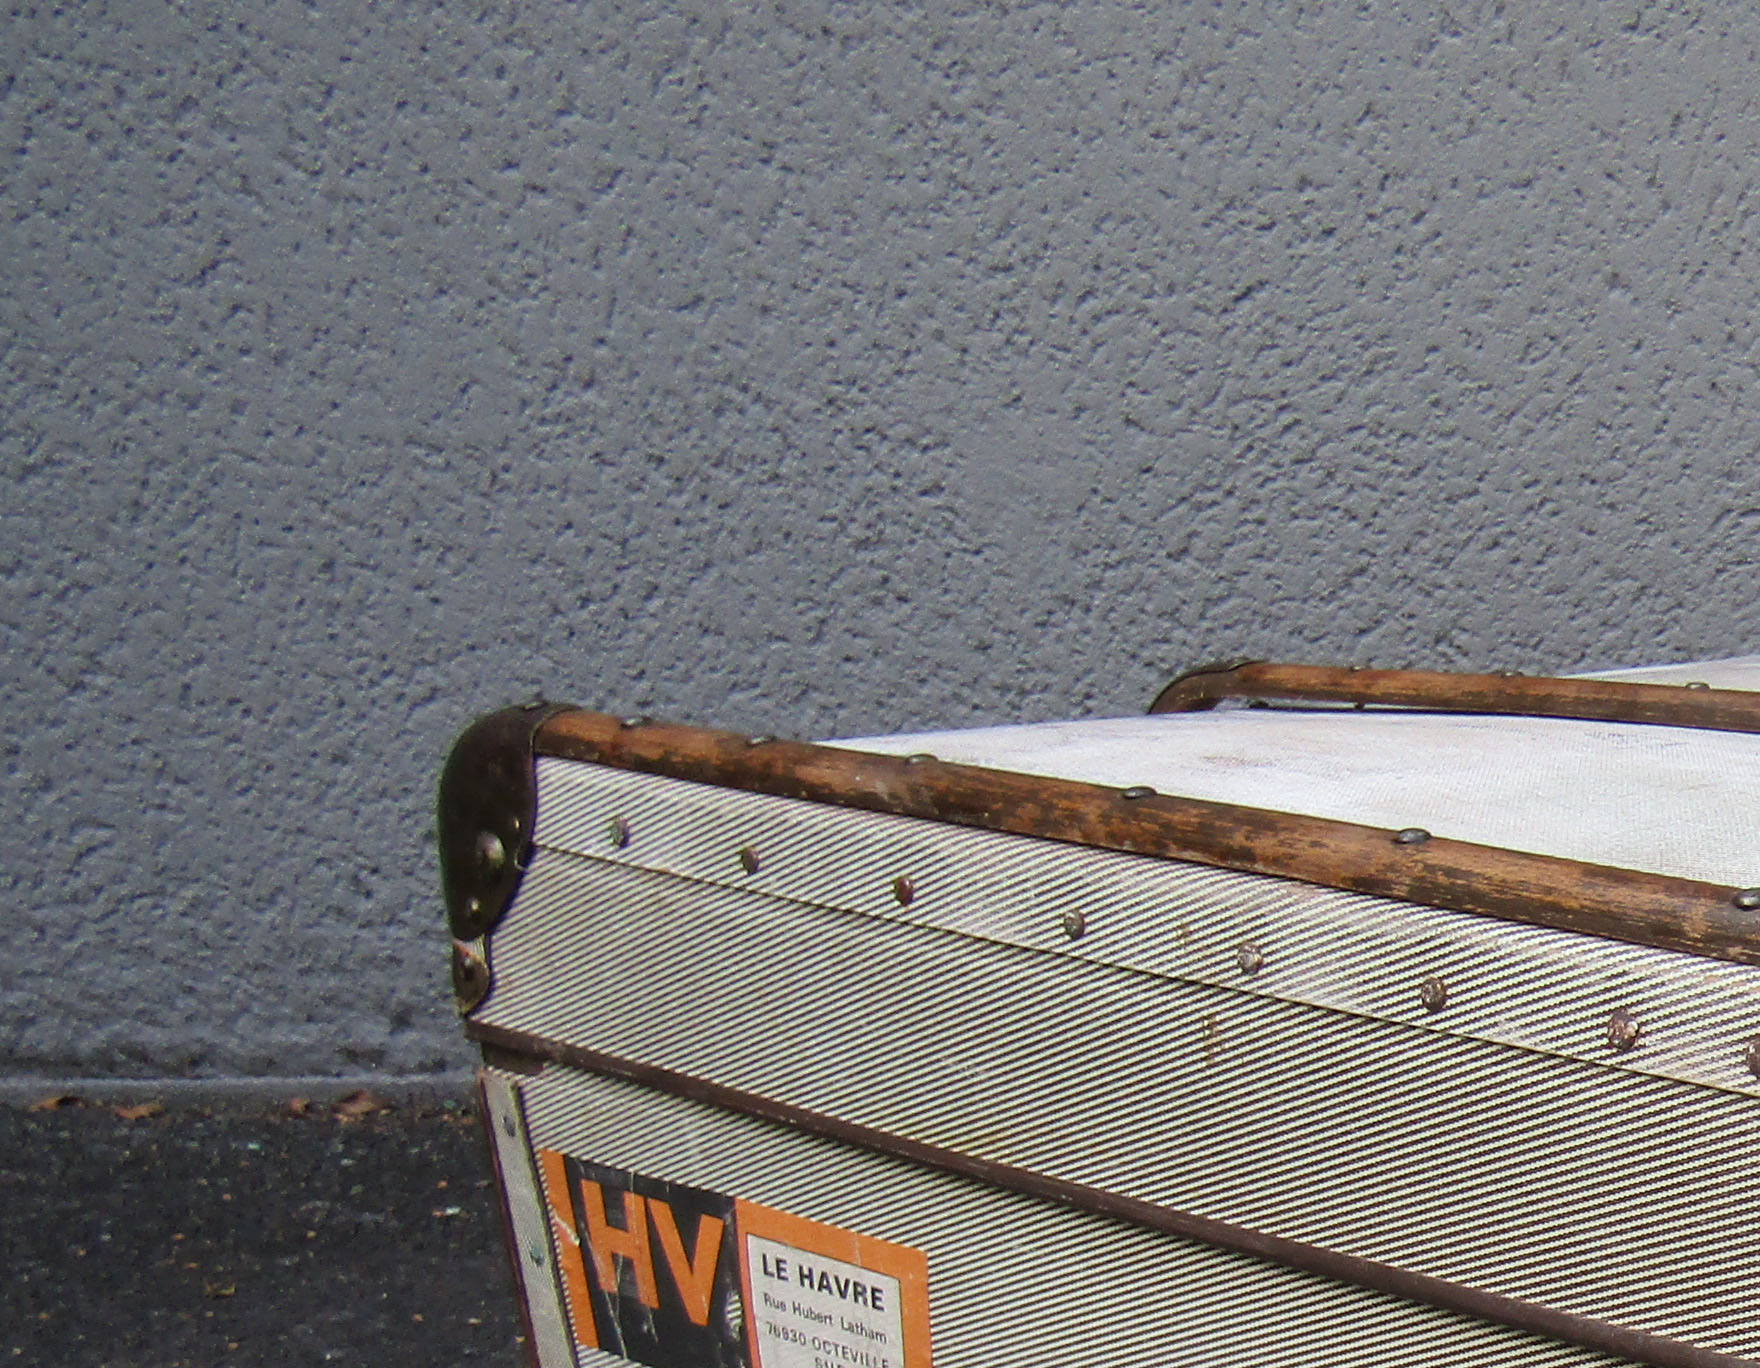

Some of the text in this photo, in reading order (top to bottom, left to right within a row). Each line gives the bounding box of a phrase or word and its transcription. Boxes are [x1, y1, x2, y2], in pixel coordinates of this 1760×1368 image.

[581, 1178, 726, 1327] HV
[762, 1253, 886, 1312] LE HAVRE
[763, 1292, 888, 1345] Rue Hubert Latham
